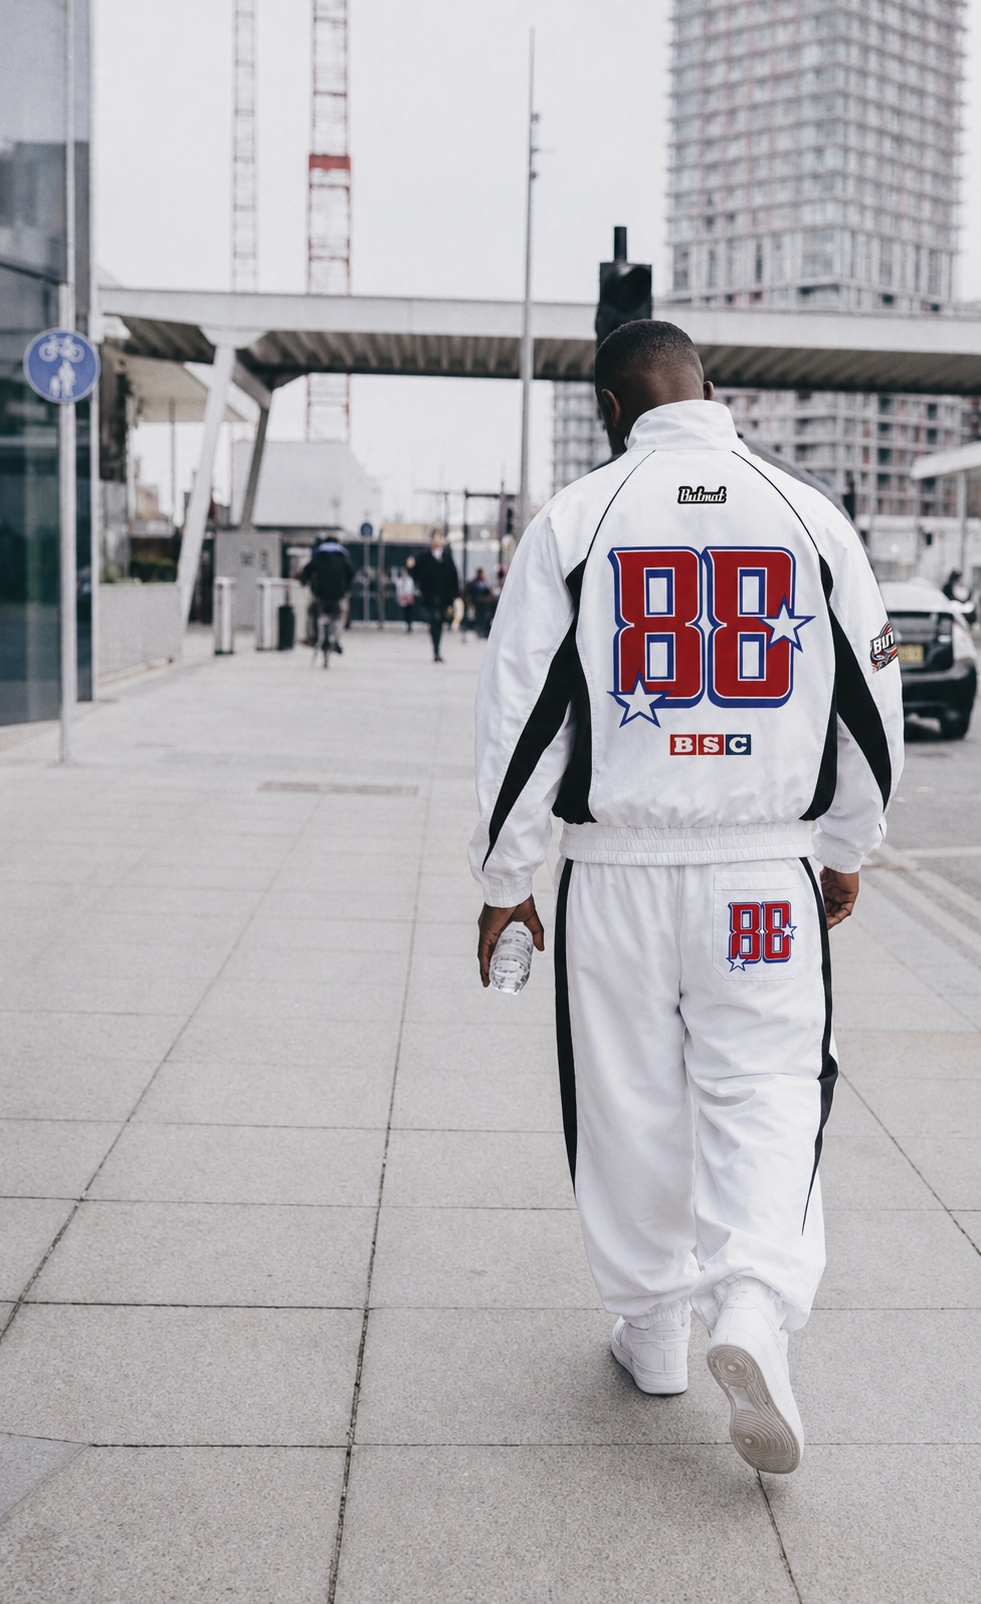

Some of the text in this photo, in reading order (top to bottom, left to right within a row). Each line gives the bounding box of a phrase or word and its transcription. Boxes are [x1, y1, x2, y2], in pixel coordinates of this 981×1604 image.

[607, 546, 796, 708] 88
[672, 736, 748, 754] BSC
[728, 901, 791, 964] 88
